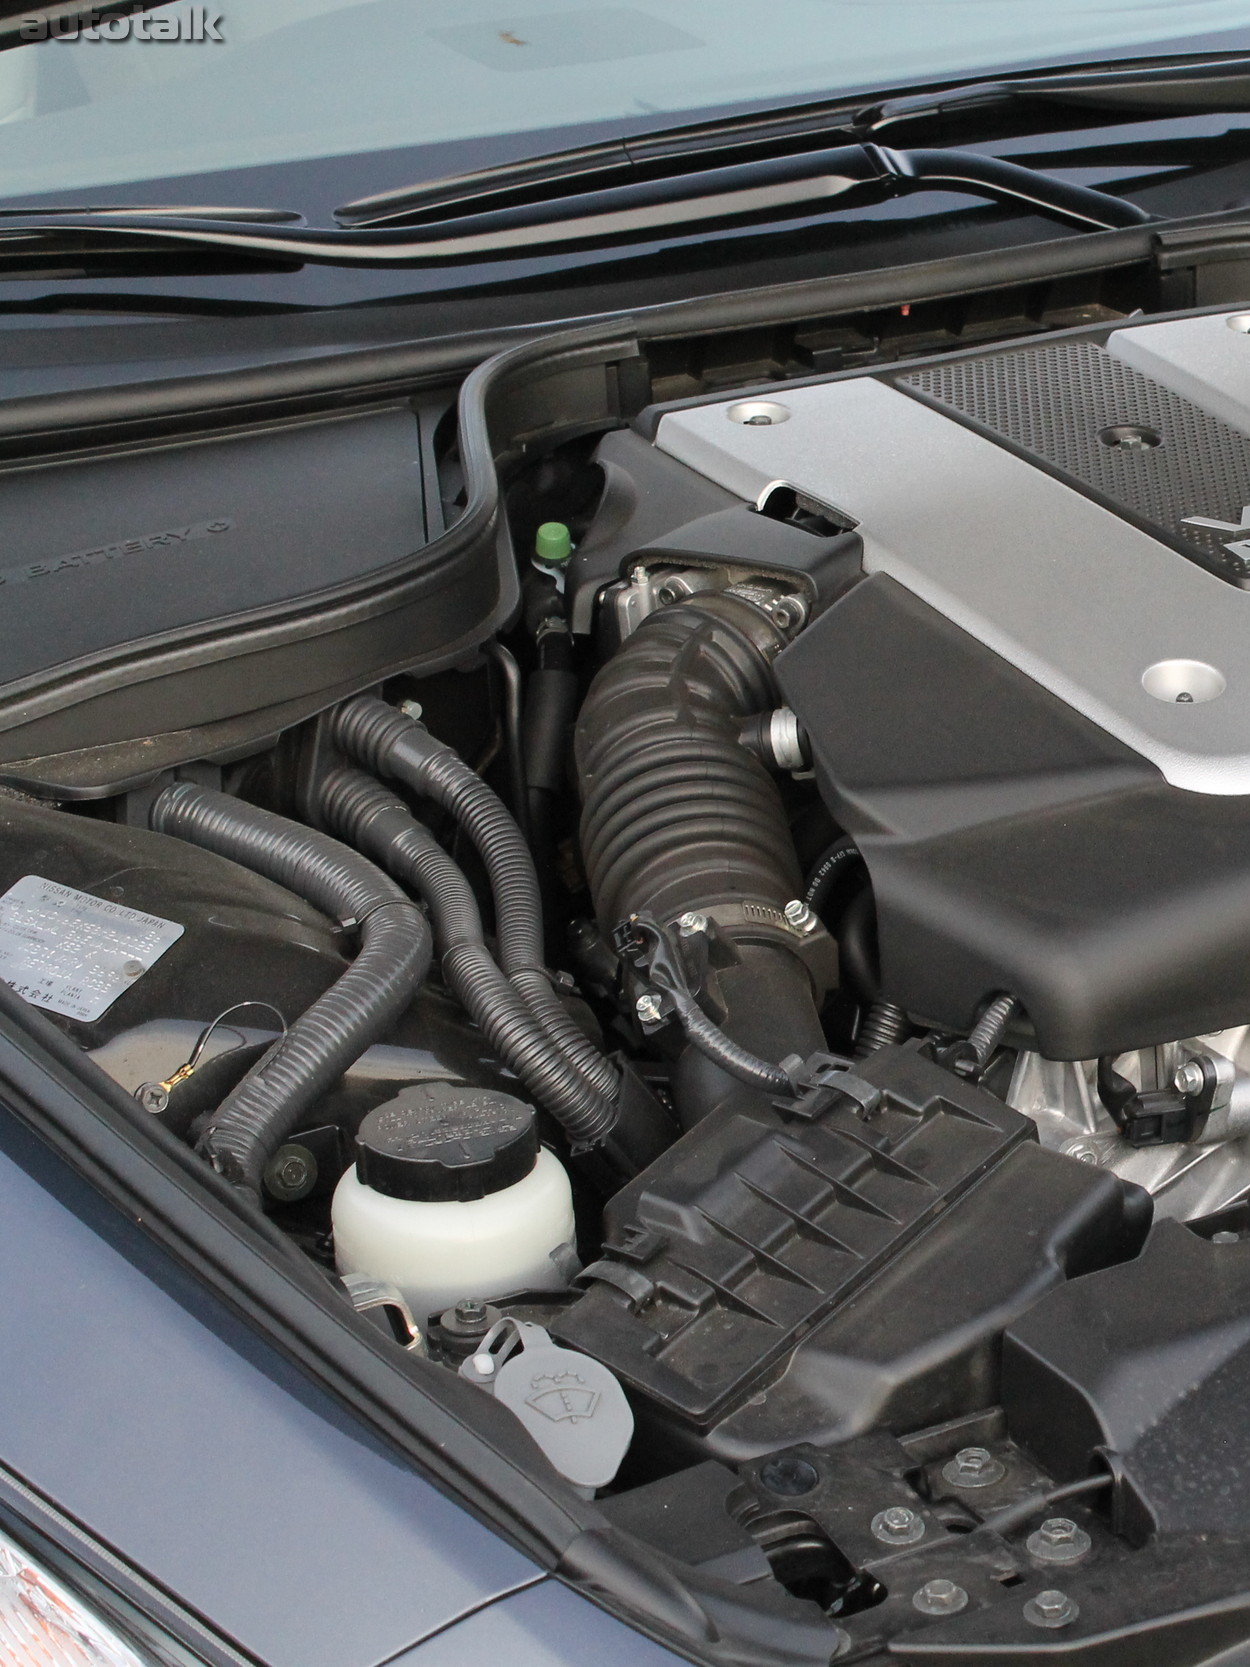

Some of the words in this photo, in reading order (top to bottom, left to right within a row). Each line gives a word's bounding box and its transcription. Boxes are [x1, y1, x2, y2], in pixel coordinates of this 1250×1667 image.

[27, 527, 191, 579] BATTERY
[39, 882, 72, 897] NISSAN
[73, 894, 102, 907] MOTOR
[137, 916, 165, 928] JAPAN
